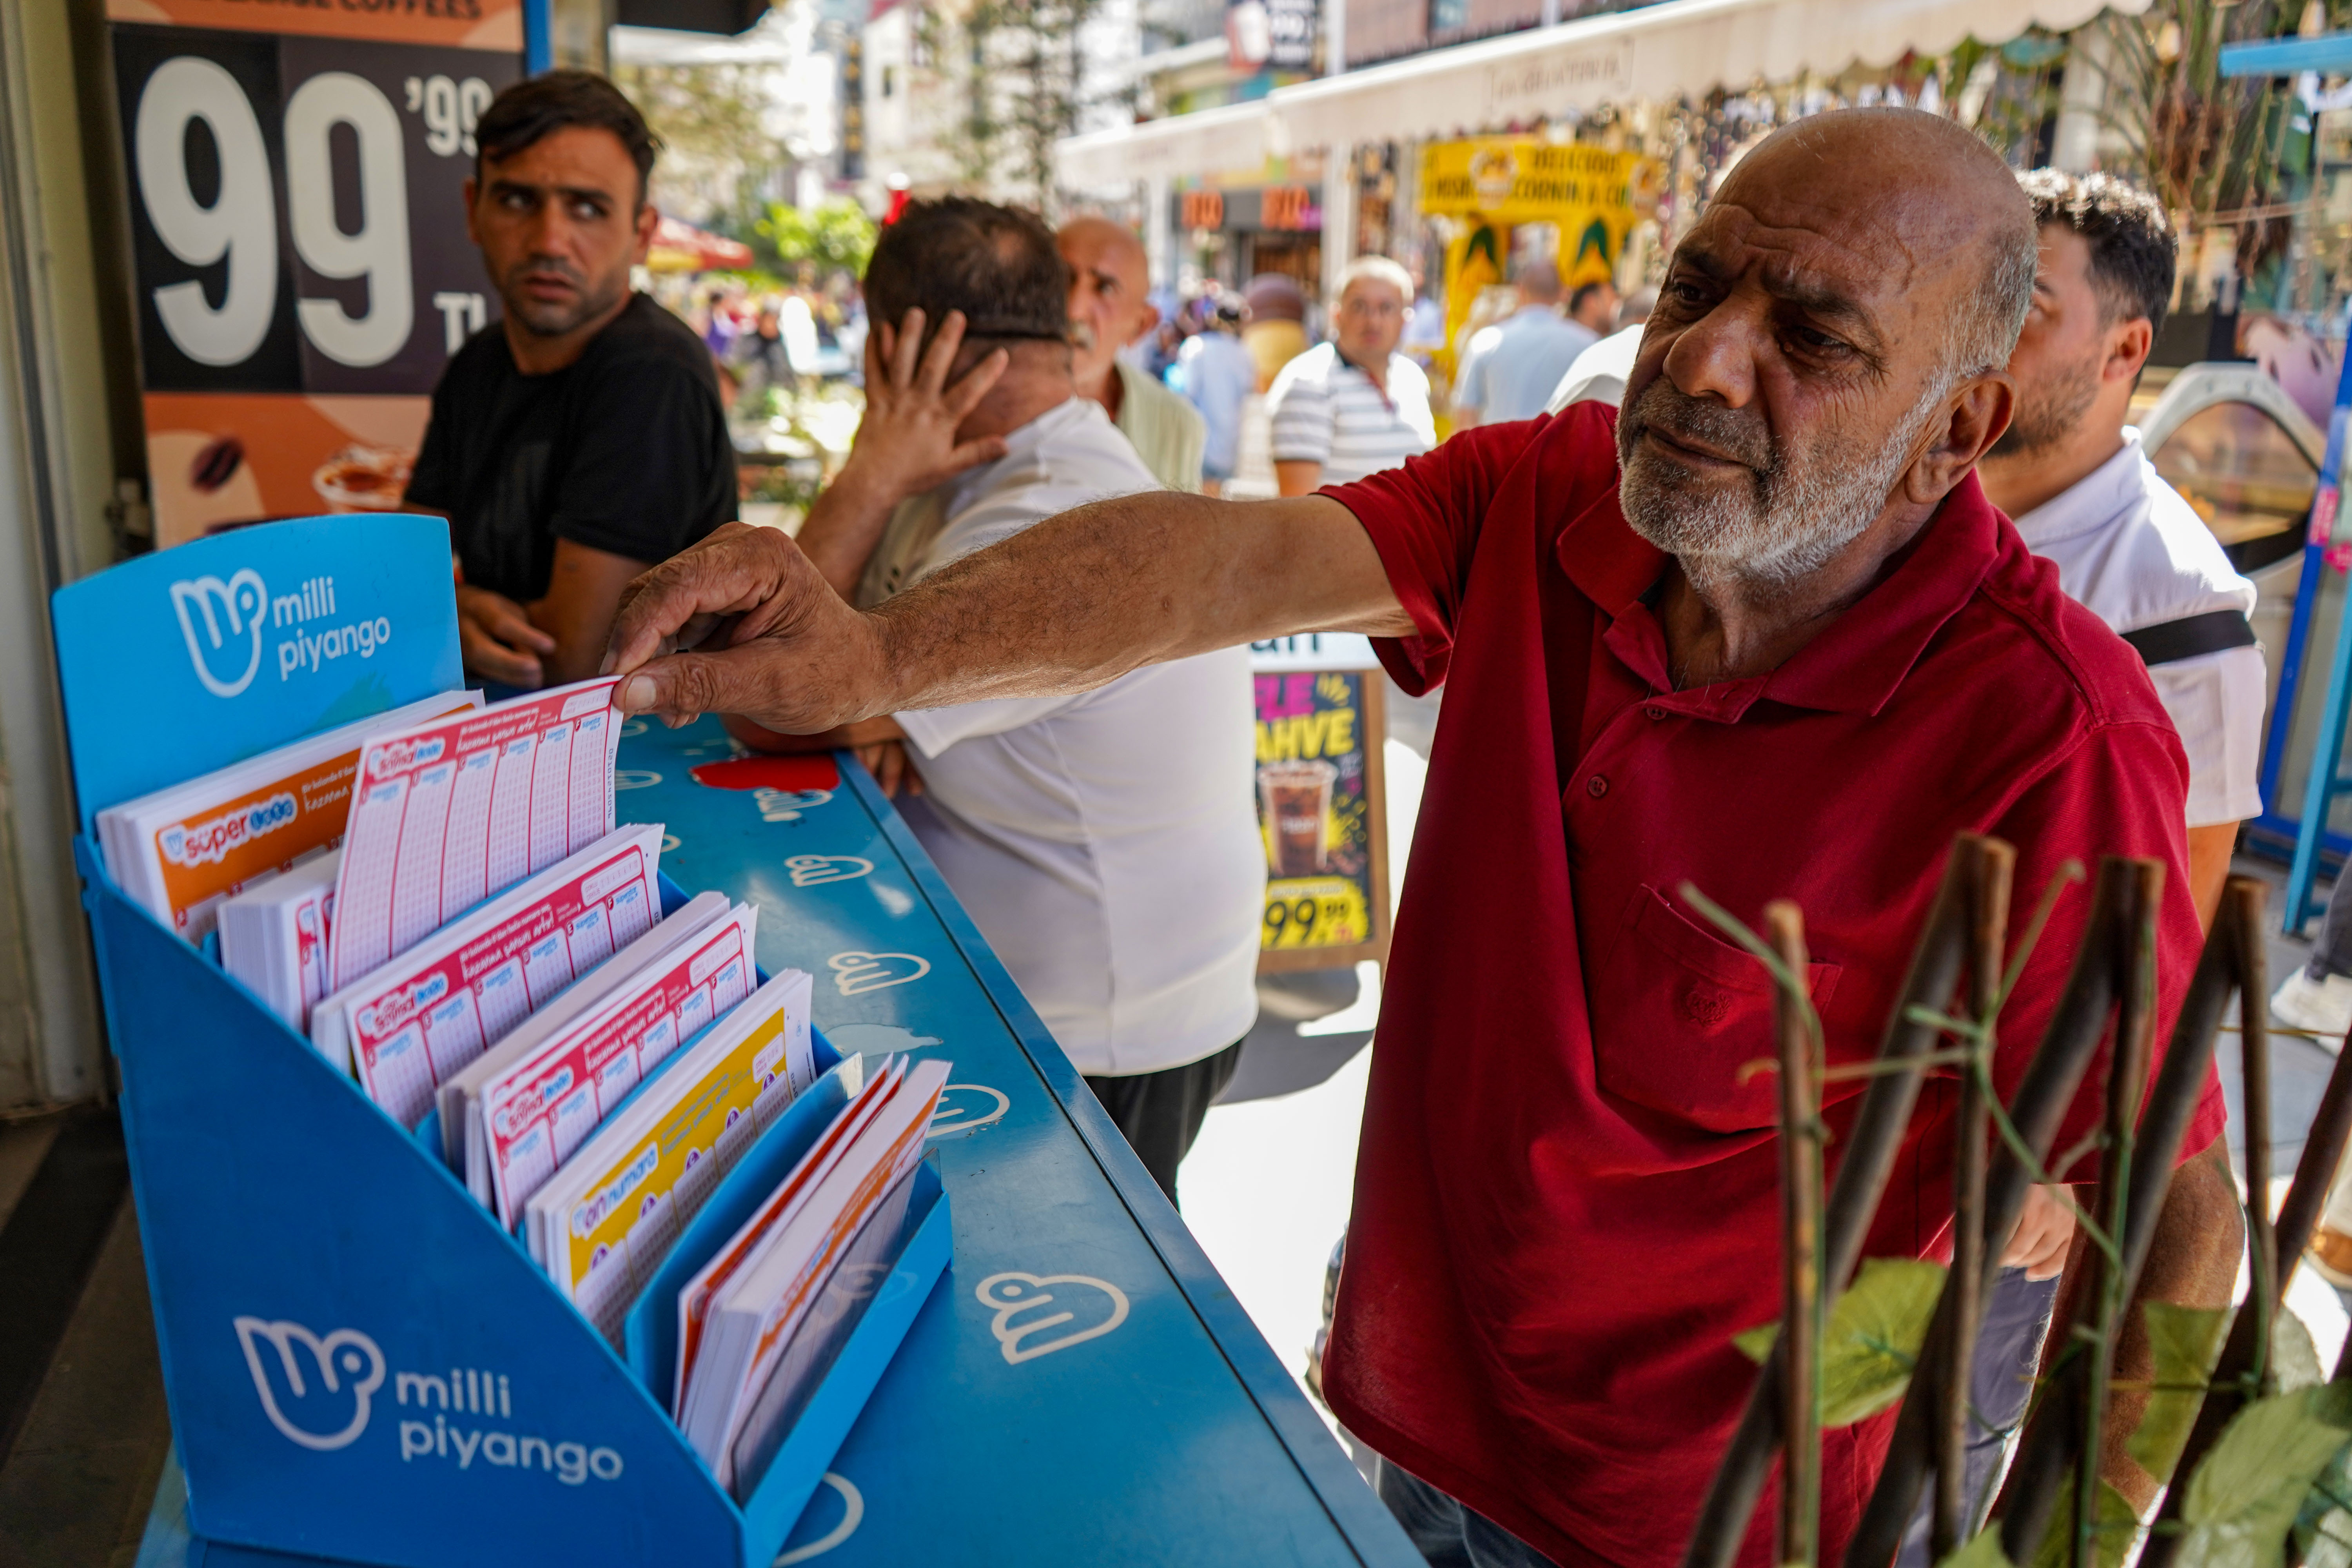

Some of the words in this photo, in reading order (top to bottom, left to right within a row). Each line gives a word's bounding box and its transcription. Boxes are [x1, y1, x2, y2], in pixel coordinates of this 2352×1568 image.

[136, 56, 414, 368] 99
[272, 575, 336, 629] milli
[278, 616, 391, 682] piyango
[1256, 707, 1356, 765] AHVE
[185, 813, 249, 860] süper
[395, 1368, 512, 1419] milli
[399, 1413, 624, 1487] piyango
